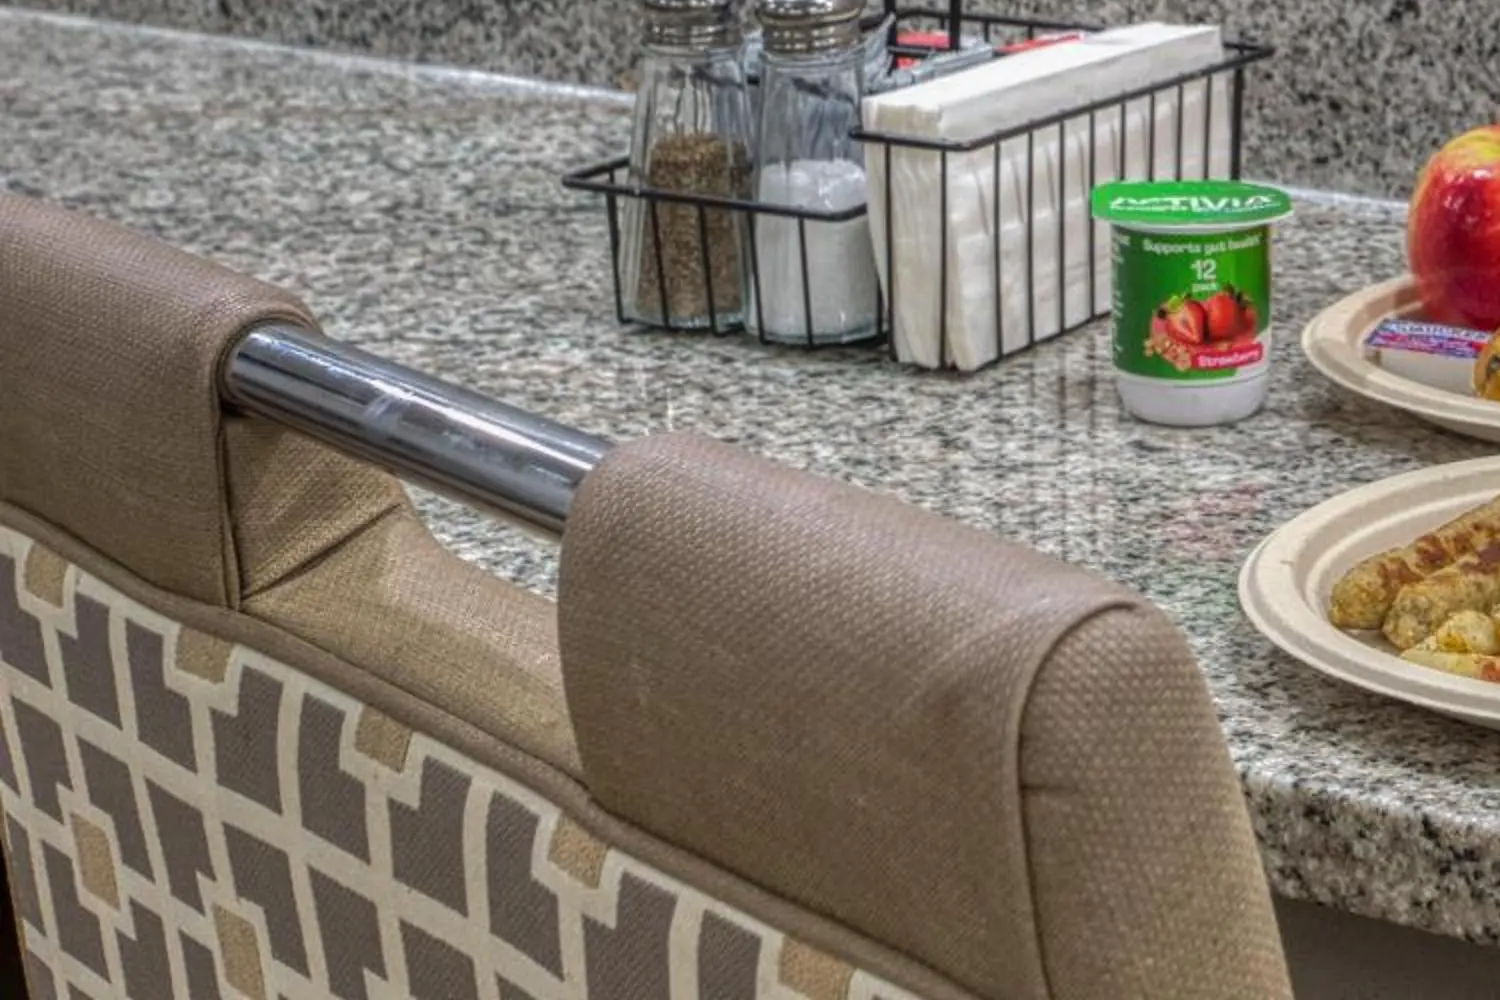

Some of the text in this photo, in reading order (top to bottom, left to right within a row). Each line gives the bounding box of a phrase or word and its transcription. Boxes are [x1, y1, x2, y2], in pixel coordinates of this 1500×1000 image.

[1109, 195, 1275, 212] ACTIVIA
[1143, 239, 1201, 255] Supports
[1191, 259, 1217, 280] 12
[1197, 349, 1260, 368] Strawberry
